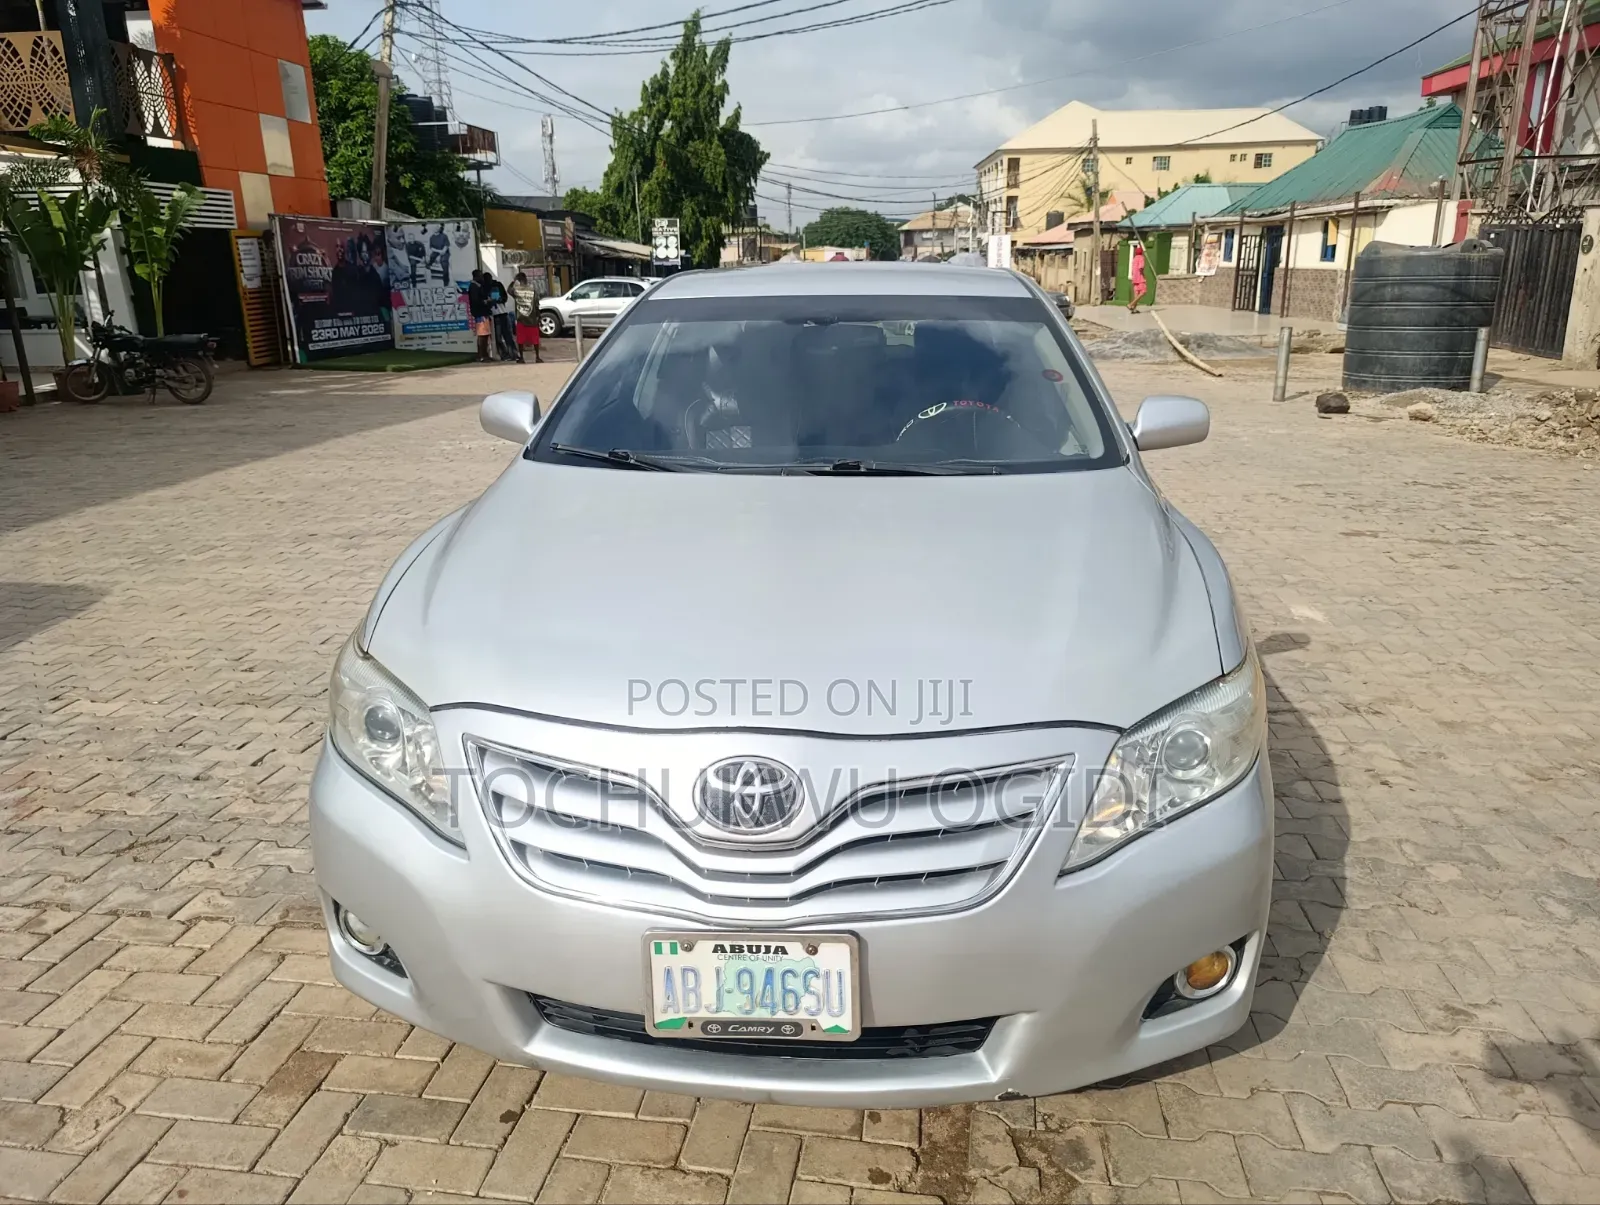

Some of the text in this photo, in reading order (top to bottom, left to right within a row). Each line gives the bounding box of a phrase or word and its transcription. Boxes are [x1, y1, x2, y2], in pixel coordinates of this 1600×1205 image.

[296, 253, 323, 266] CRAZY
[307, 266, 333, 282] SHORT
[401, 287, 457, 307] VIBES
[397, 303, 468, 324] STEEZE
[311, 328, 339, 341] 23RD
[339, 326, 361, 338] MAY
[953, 400, 999, 413] TOYOTA
[712, 943, 789, 955] ABUJA
[748, 954, 761, 962] OF
